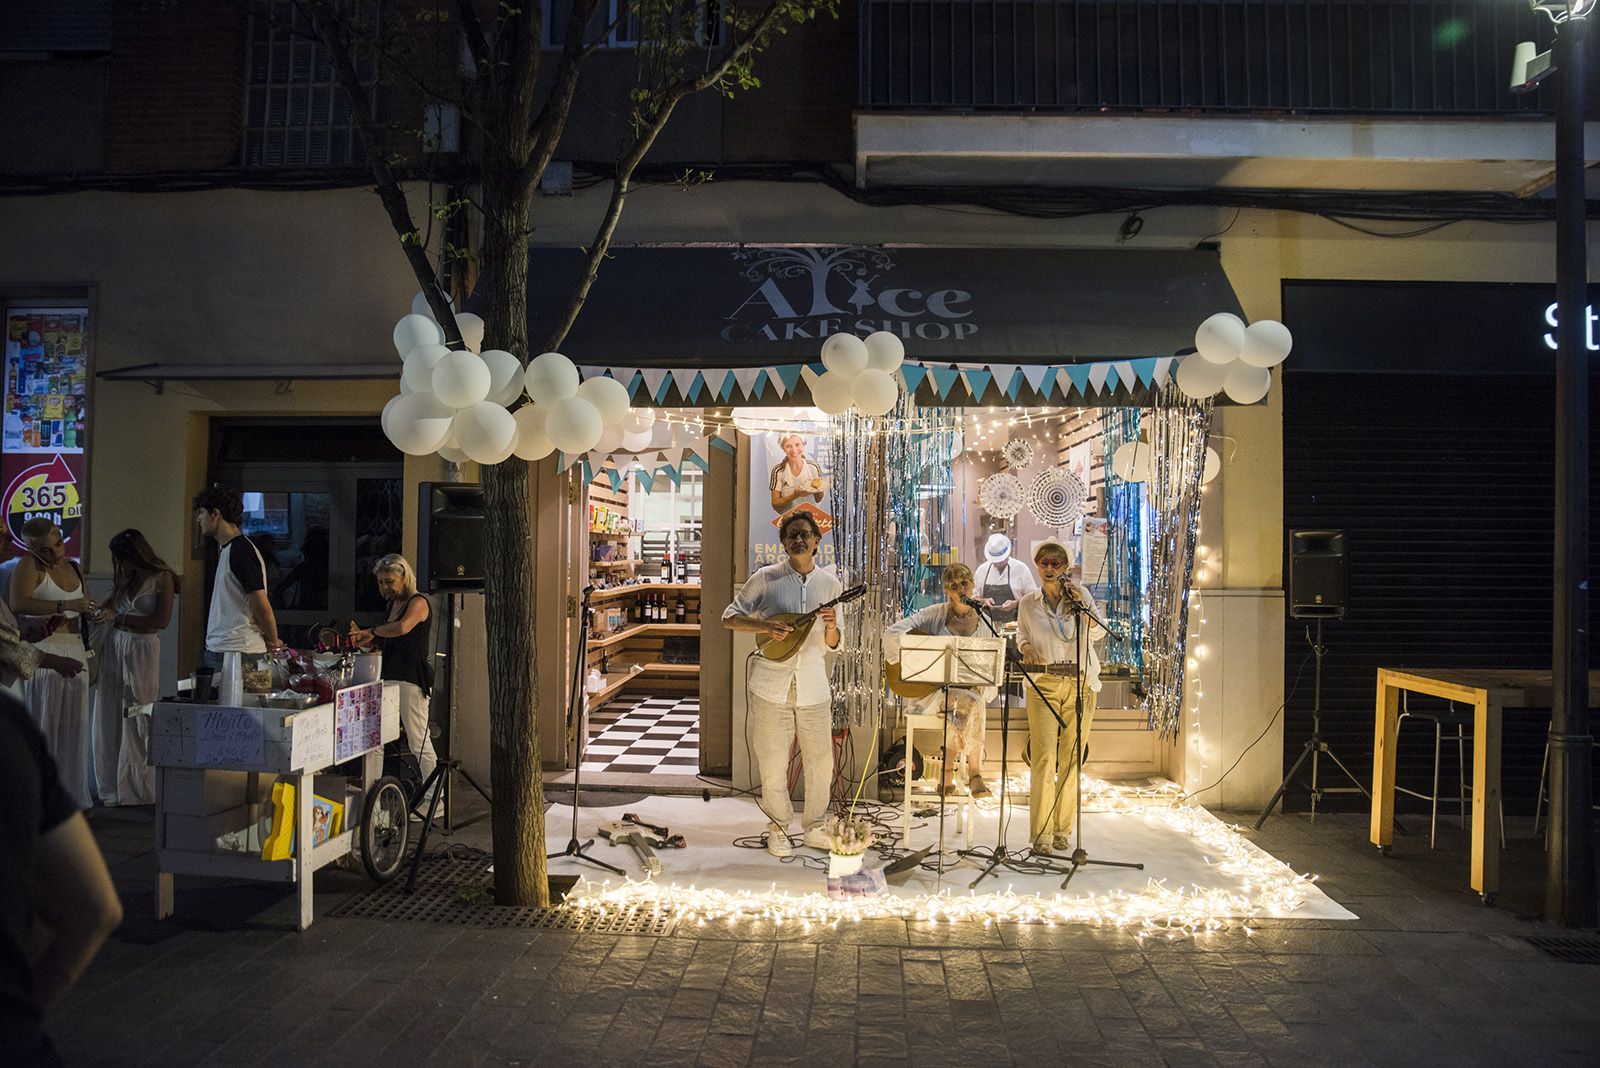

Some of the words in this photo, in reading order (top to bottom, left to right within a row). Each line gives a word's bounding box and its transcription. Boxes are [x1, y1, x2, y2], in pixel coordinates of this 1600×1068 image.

[720, 318, 841, 341] CAKE
[854, 319, 978, 340] SHOP
[22, 485, 66, 508] 365
